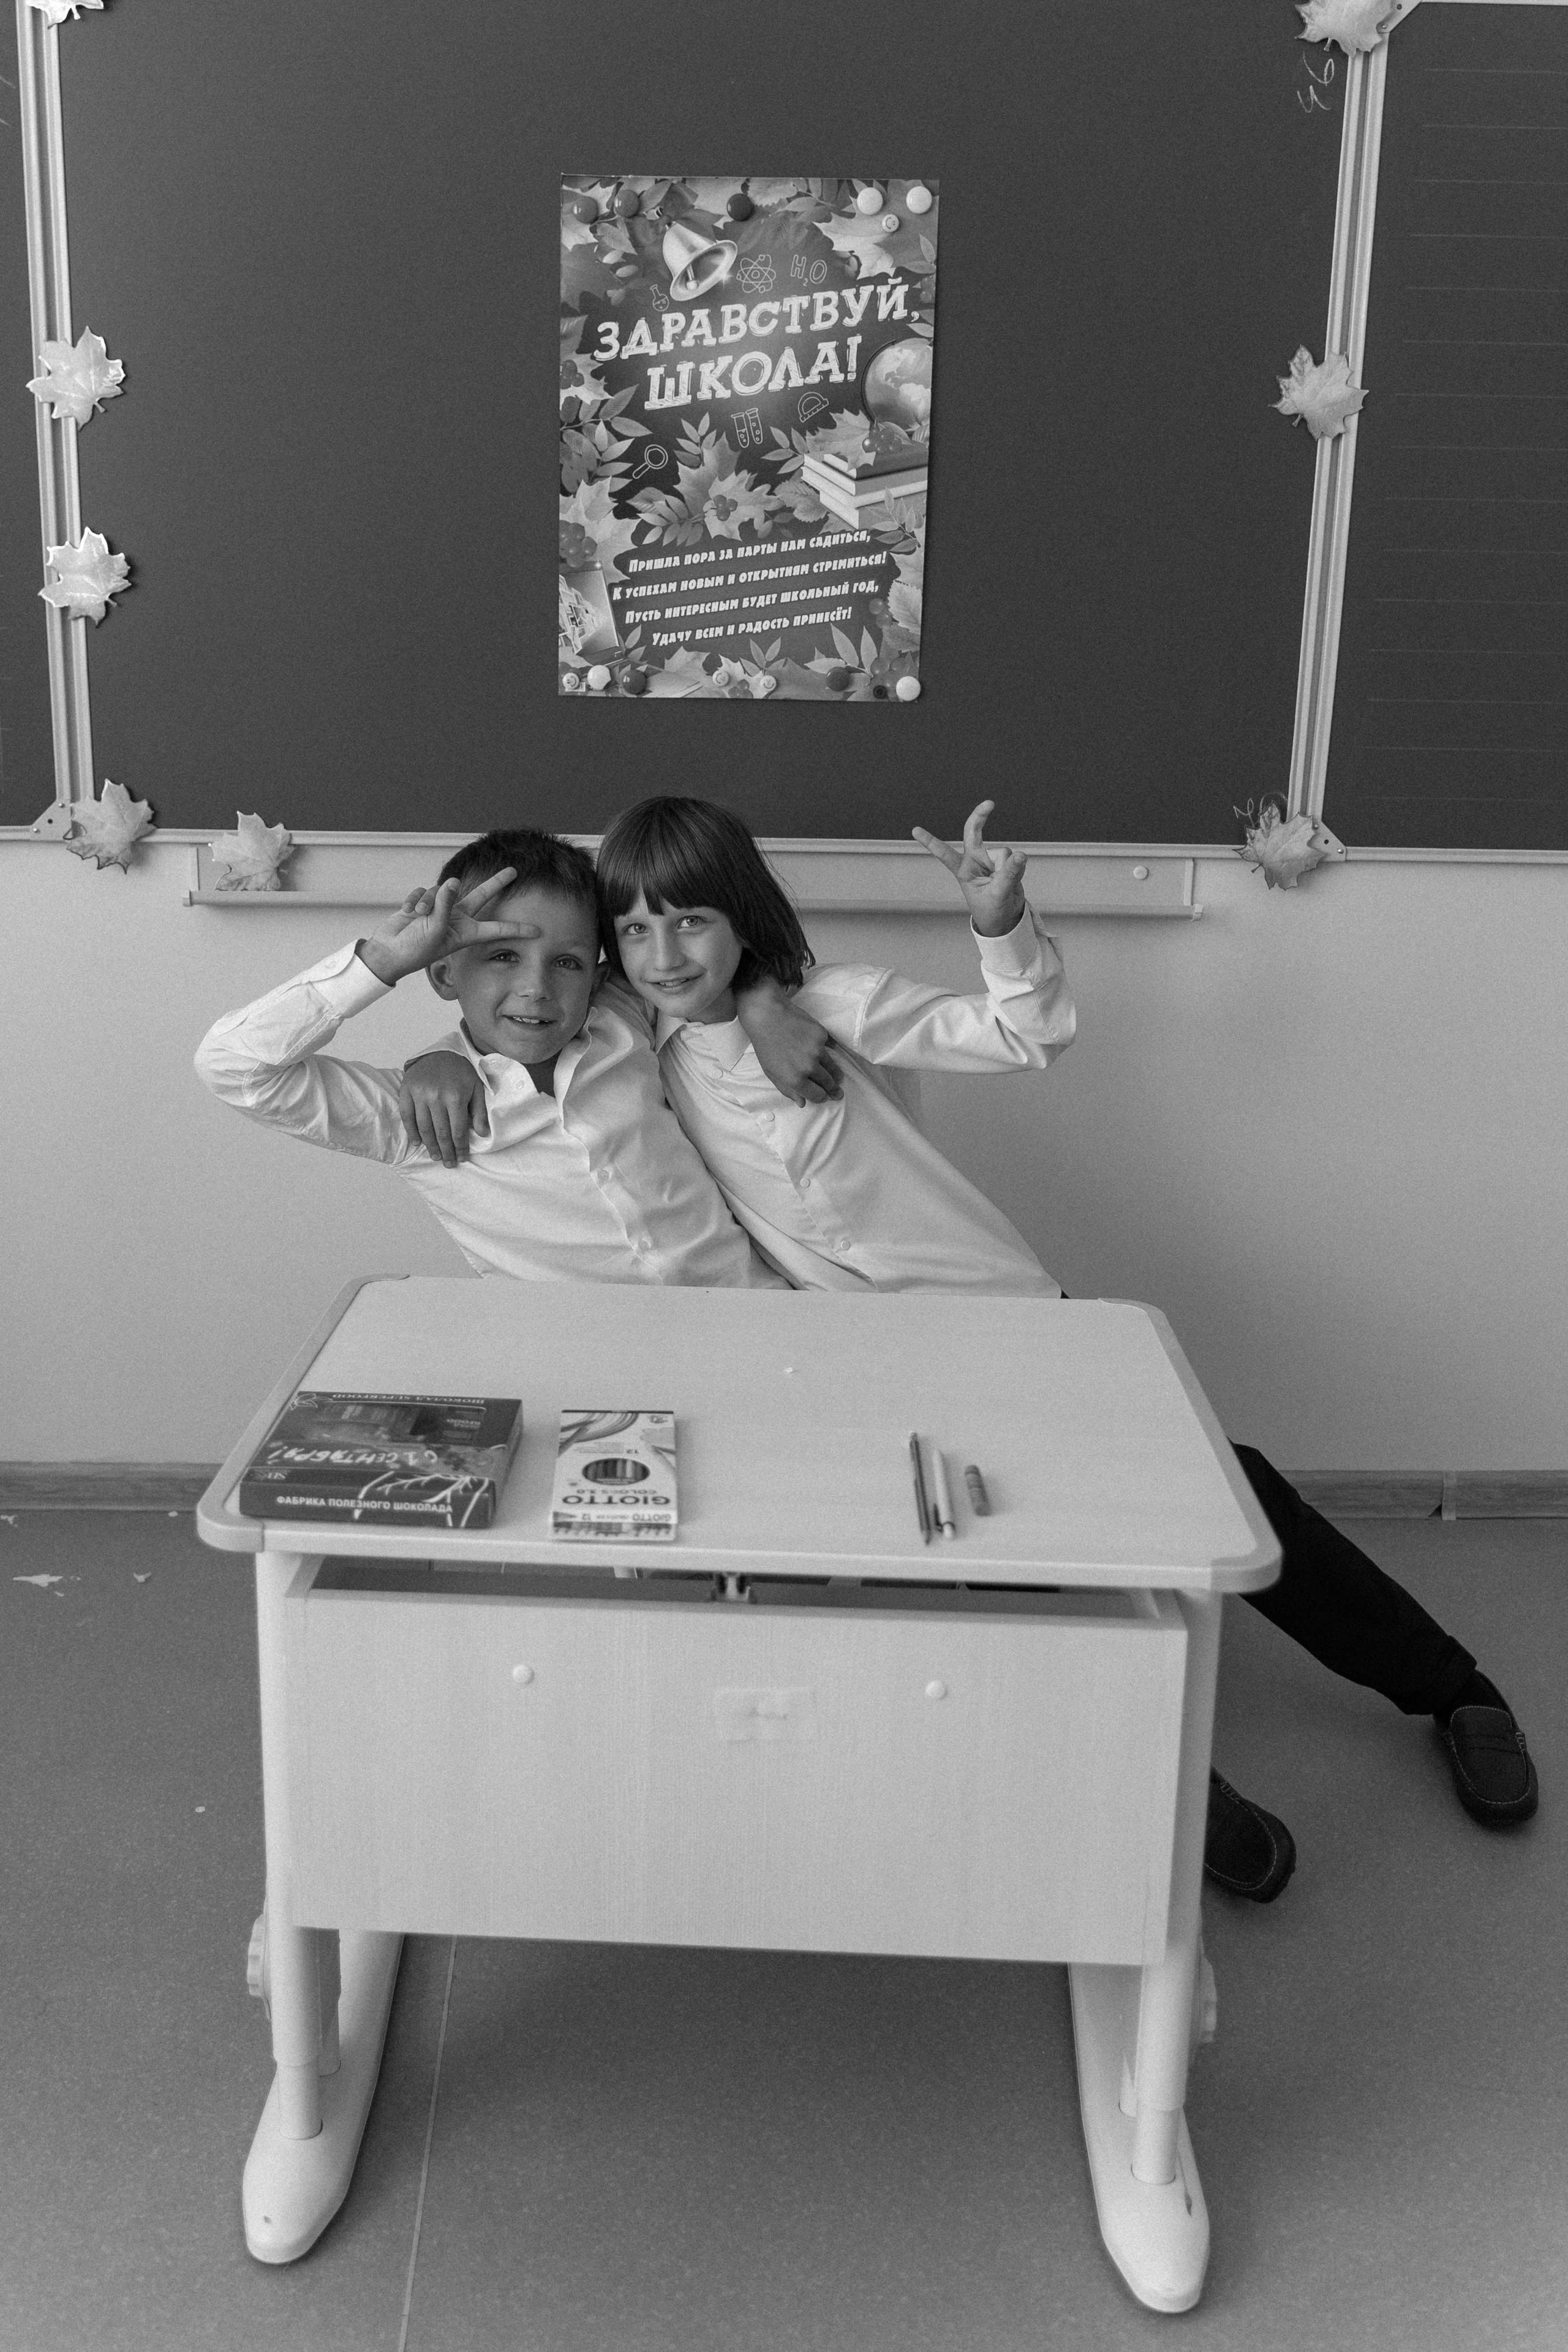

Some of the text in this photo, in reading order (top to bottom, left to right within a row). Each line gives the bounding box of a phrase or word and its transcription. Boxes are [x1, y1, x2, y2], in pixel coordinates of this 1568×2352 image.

[594, 277, 921, 361] ЗДРАВСТВУЙ,
[644, 334, 862, 410] ШКОЛА!
[629, 530, 870, 573] ПРИШЛА ПОРА ЗА ПАРТЫ НАМ САДИТЬСЯ,
[612, 551, 887, 600] К УСПЕХАМ НОВЫМ И ОТКРЫТИЯМ СТРЕМИТЬСЯ!
[625, 580, 879, 624] ПУСТЬ ИНТЕРЕСНЫМ БУДЕТ ШКОЛЬНЫЙ ГОД,
[652, 606, 853, 646] УДАЧУ ВСЕМ И РАДОСТЬ ПРИНЕСЁТ!
[276, 1496, 453, 1513] ФАБРИКА ПОЛЕЗНОГО ШОКОЛАДА
[562, 1495, 670, 1504] GIOTTO
